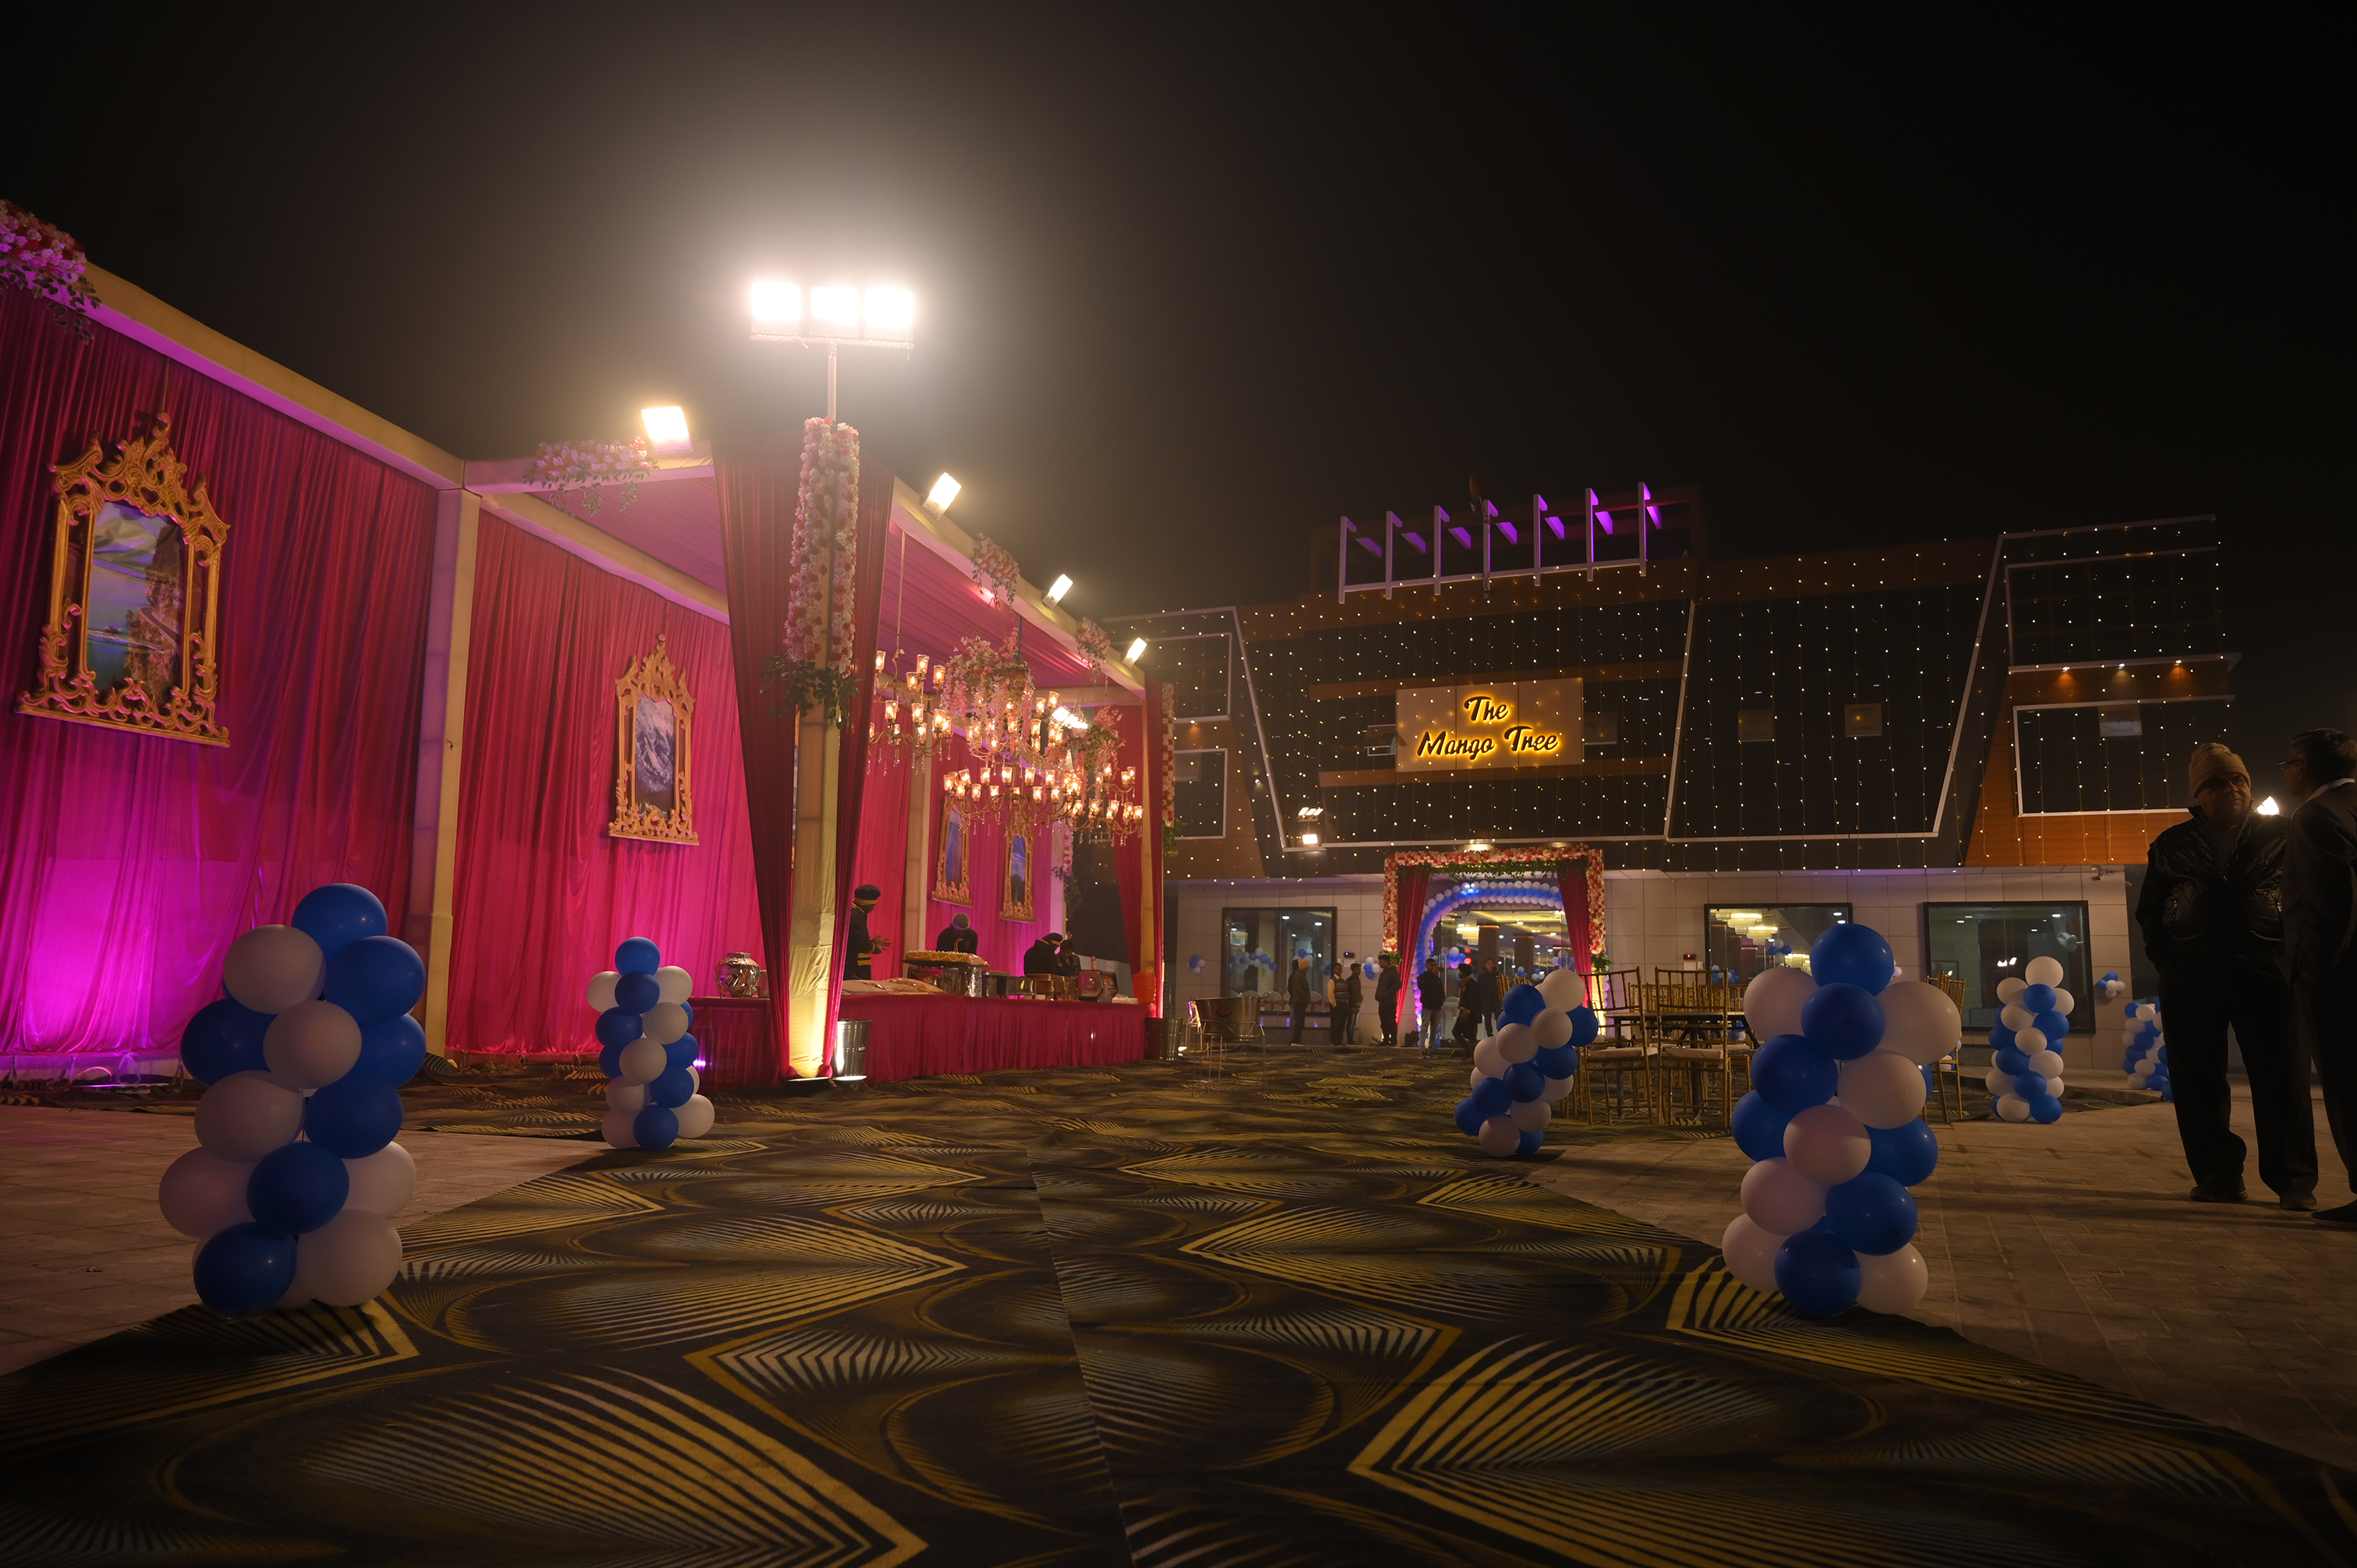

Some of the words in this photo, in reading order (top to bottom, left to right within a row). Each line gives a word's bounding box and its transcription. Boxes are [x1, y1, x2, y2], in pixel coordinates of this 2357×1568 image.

[1463, 695, 1509, 722] The
[1416, 730, 1496, 761] Mango
[1504, 725, 1559, 752] Tree
